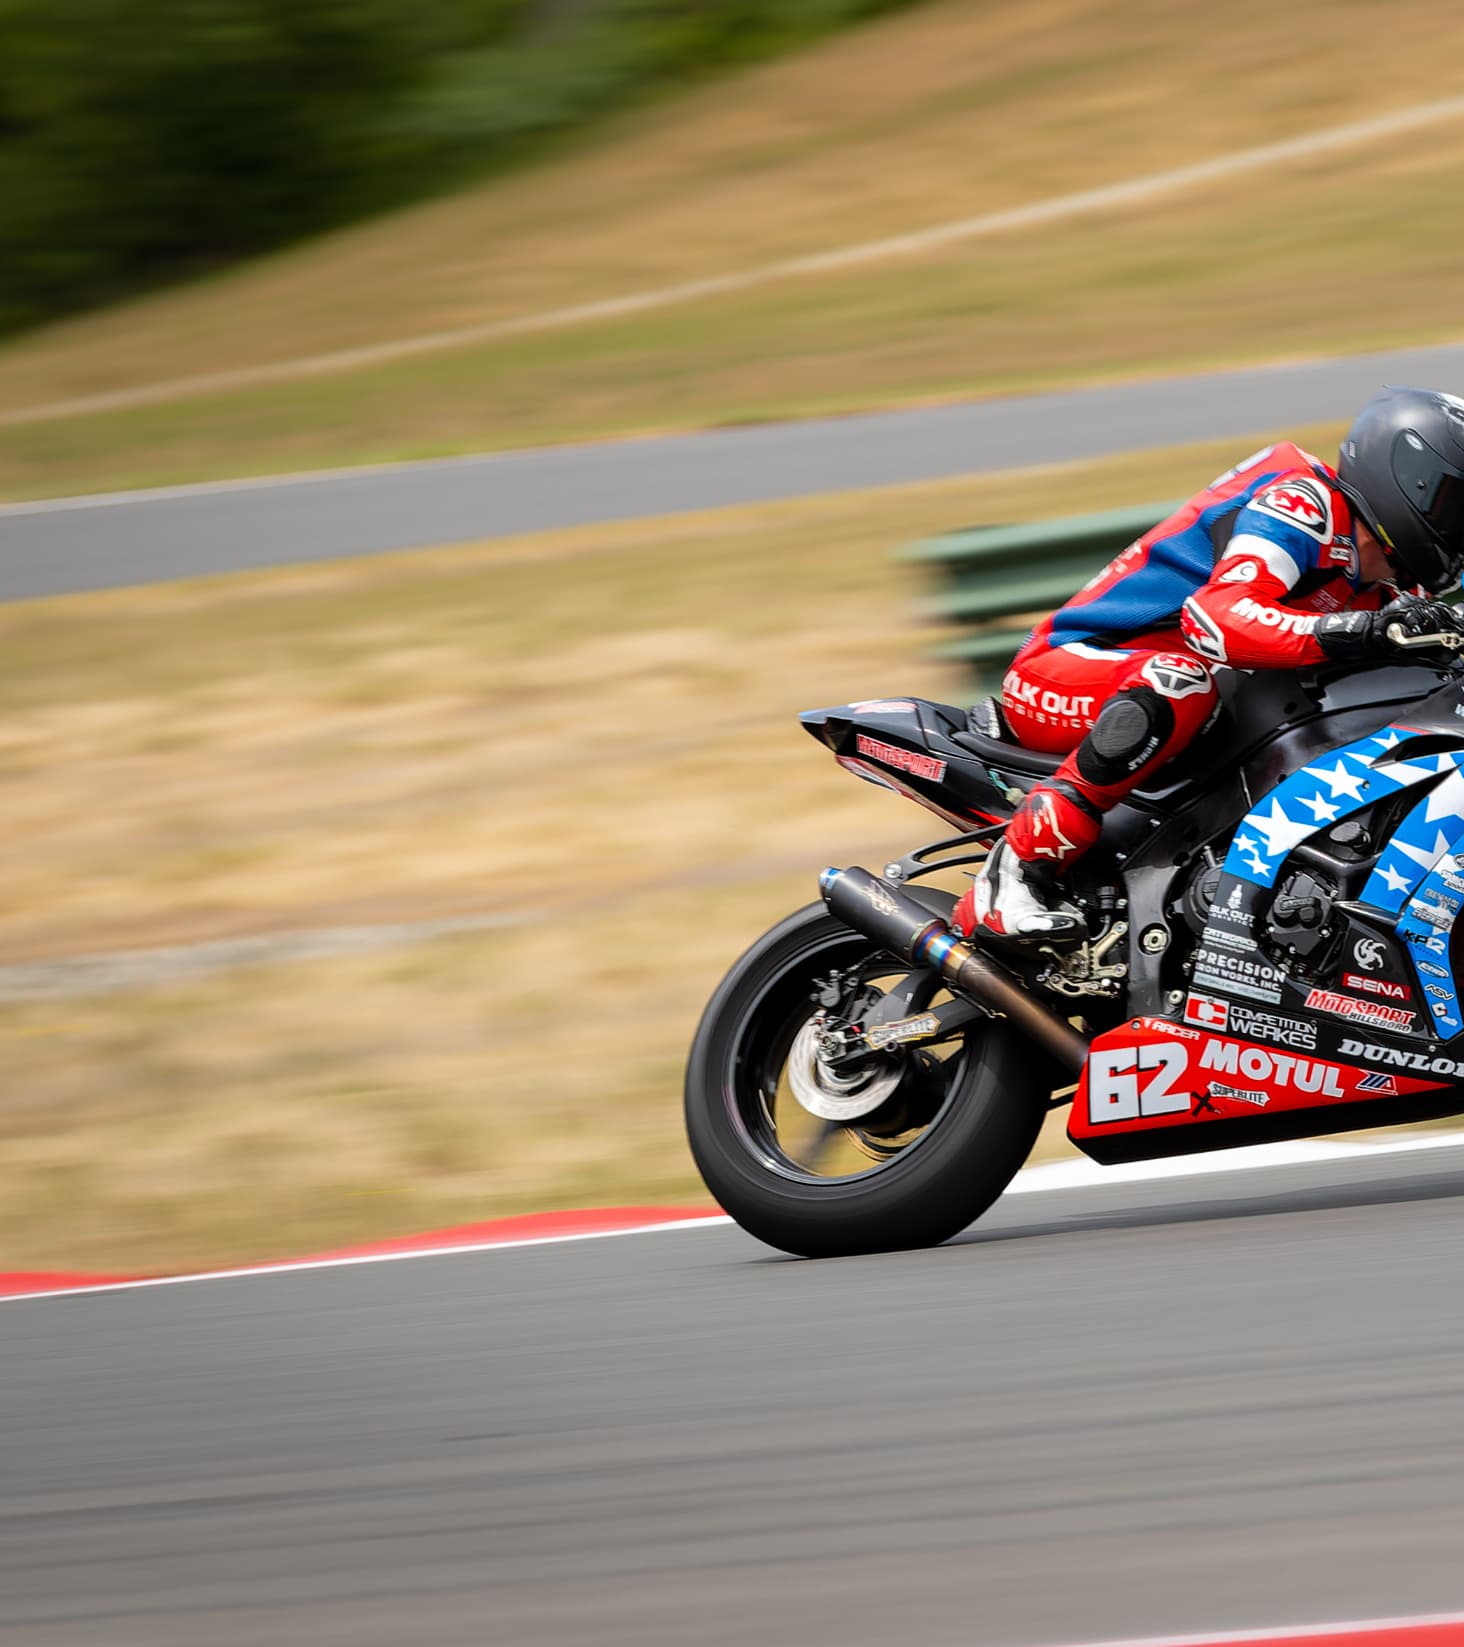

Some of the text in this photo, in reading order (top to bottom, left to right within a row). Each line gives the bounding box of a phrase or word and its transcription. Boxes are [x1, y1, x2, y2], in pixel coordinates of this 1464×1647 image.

[1041, 691, 1095, 716] OUT
[1195, 962, 1219, 976] IRON
[1261, 980, 1283, 993] INC.
[1197, 949, 1286, 983] PRECISION
[1347, 975, 1405, 998] SENA
[1230, 1006, 1318, 1036] COMPETITION
[1230, 1018, 1317, 1050] WERKES
[1349, 1012, 1411, 1032] HILLSBORO
[1089, 1041, 1191, 1124] 62
[1199, 1040, 1345, 1098] MOTUL
[1211, 1084, 1266, 1105] SUPERLITE
